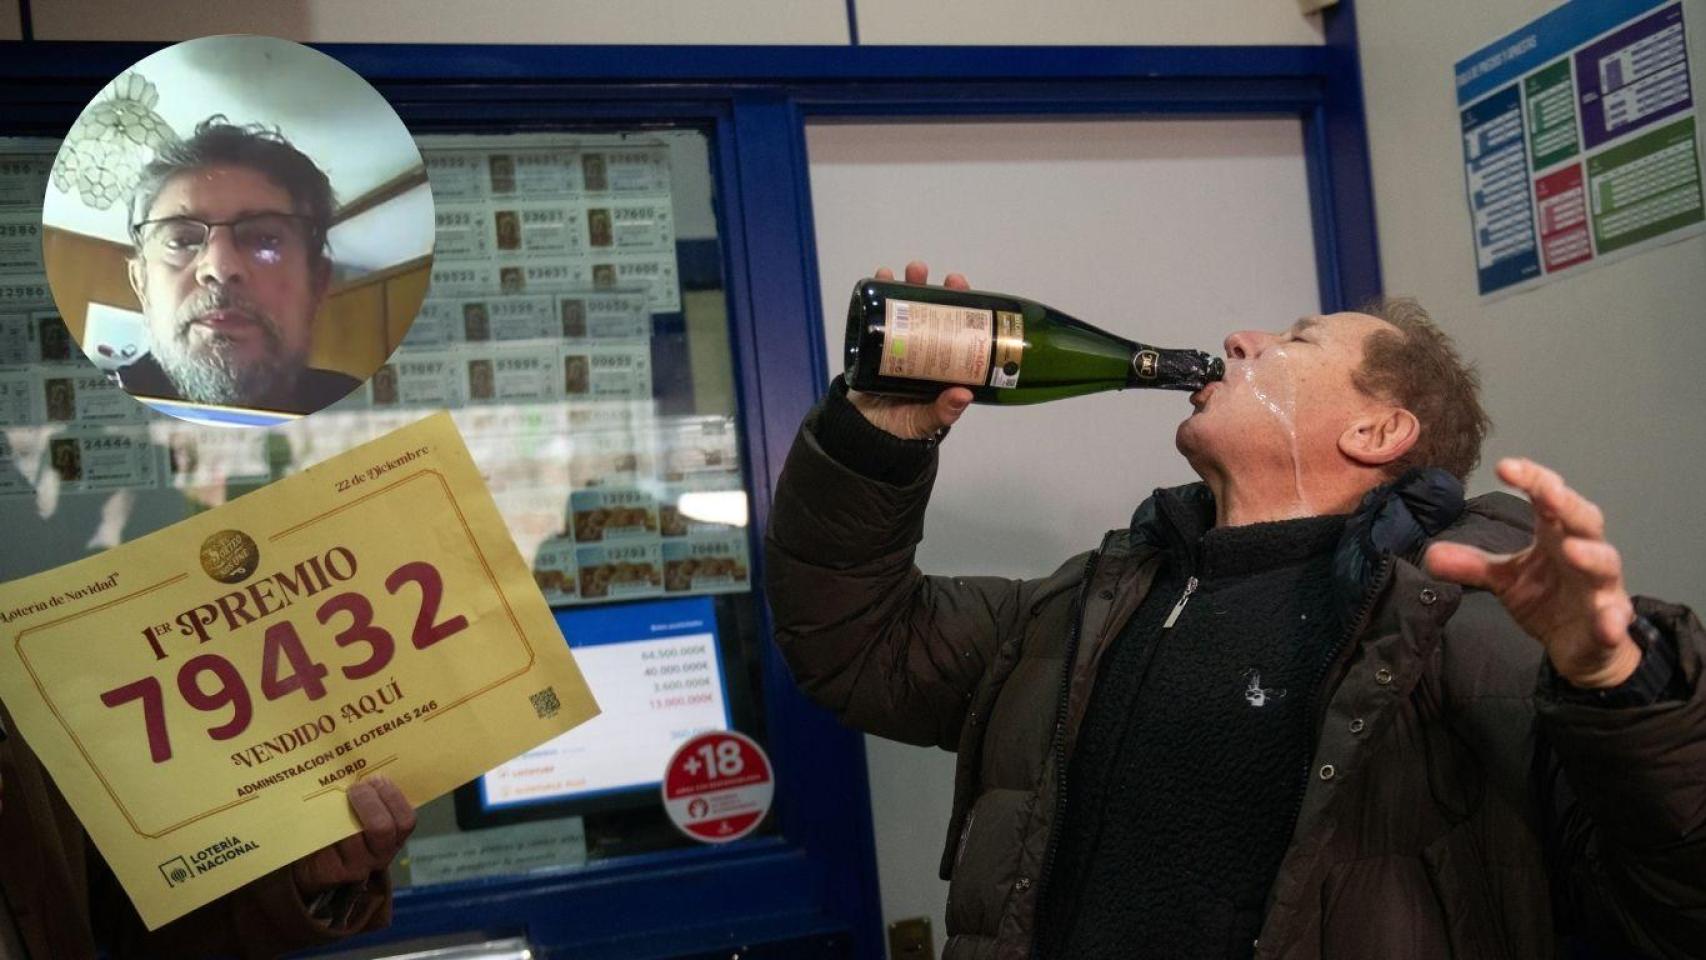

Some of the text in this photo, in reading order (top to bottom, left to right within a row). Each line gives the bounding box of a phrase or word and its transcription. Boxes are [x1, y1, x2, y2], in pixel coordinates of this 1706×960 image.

[335, 446, 429, 492] 22 de Diciembre
[49, 596, 66, 607] de
[176, 547, 358, 645] PREMIO
[100, 561, 469, 763] 79432
[231, 677, 404, 769] VENDIDO AQUÍ
[237, 700, 439, 797] ADMINISTRACION DE LOTERIAS 246
[682, 740, 745, 781] +18
[318, 758, 368, 788] MADRID
[196, 841, 260, 874] NACIONAL
